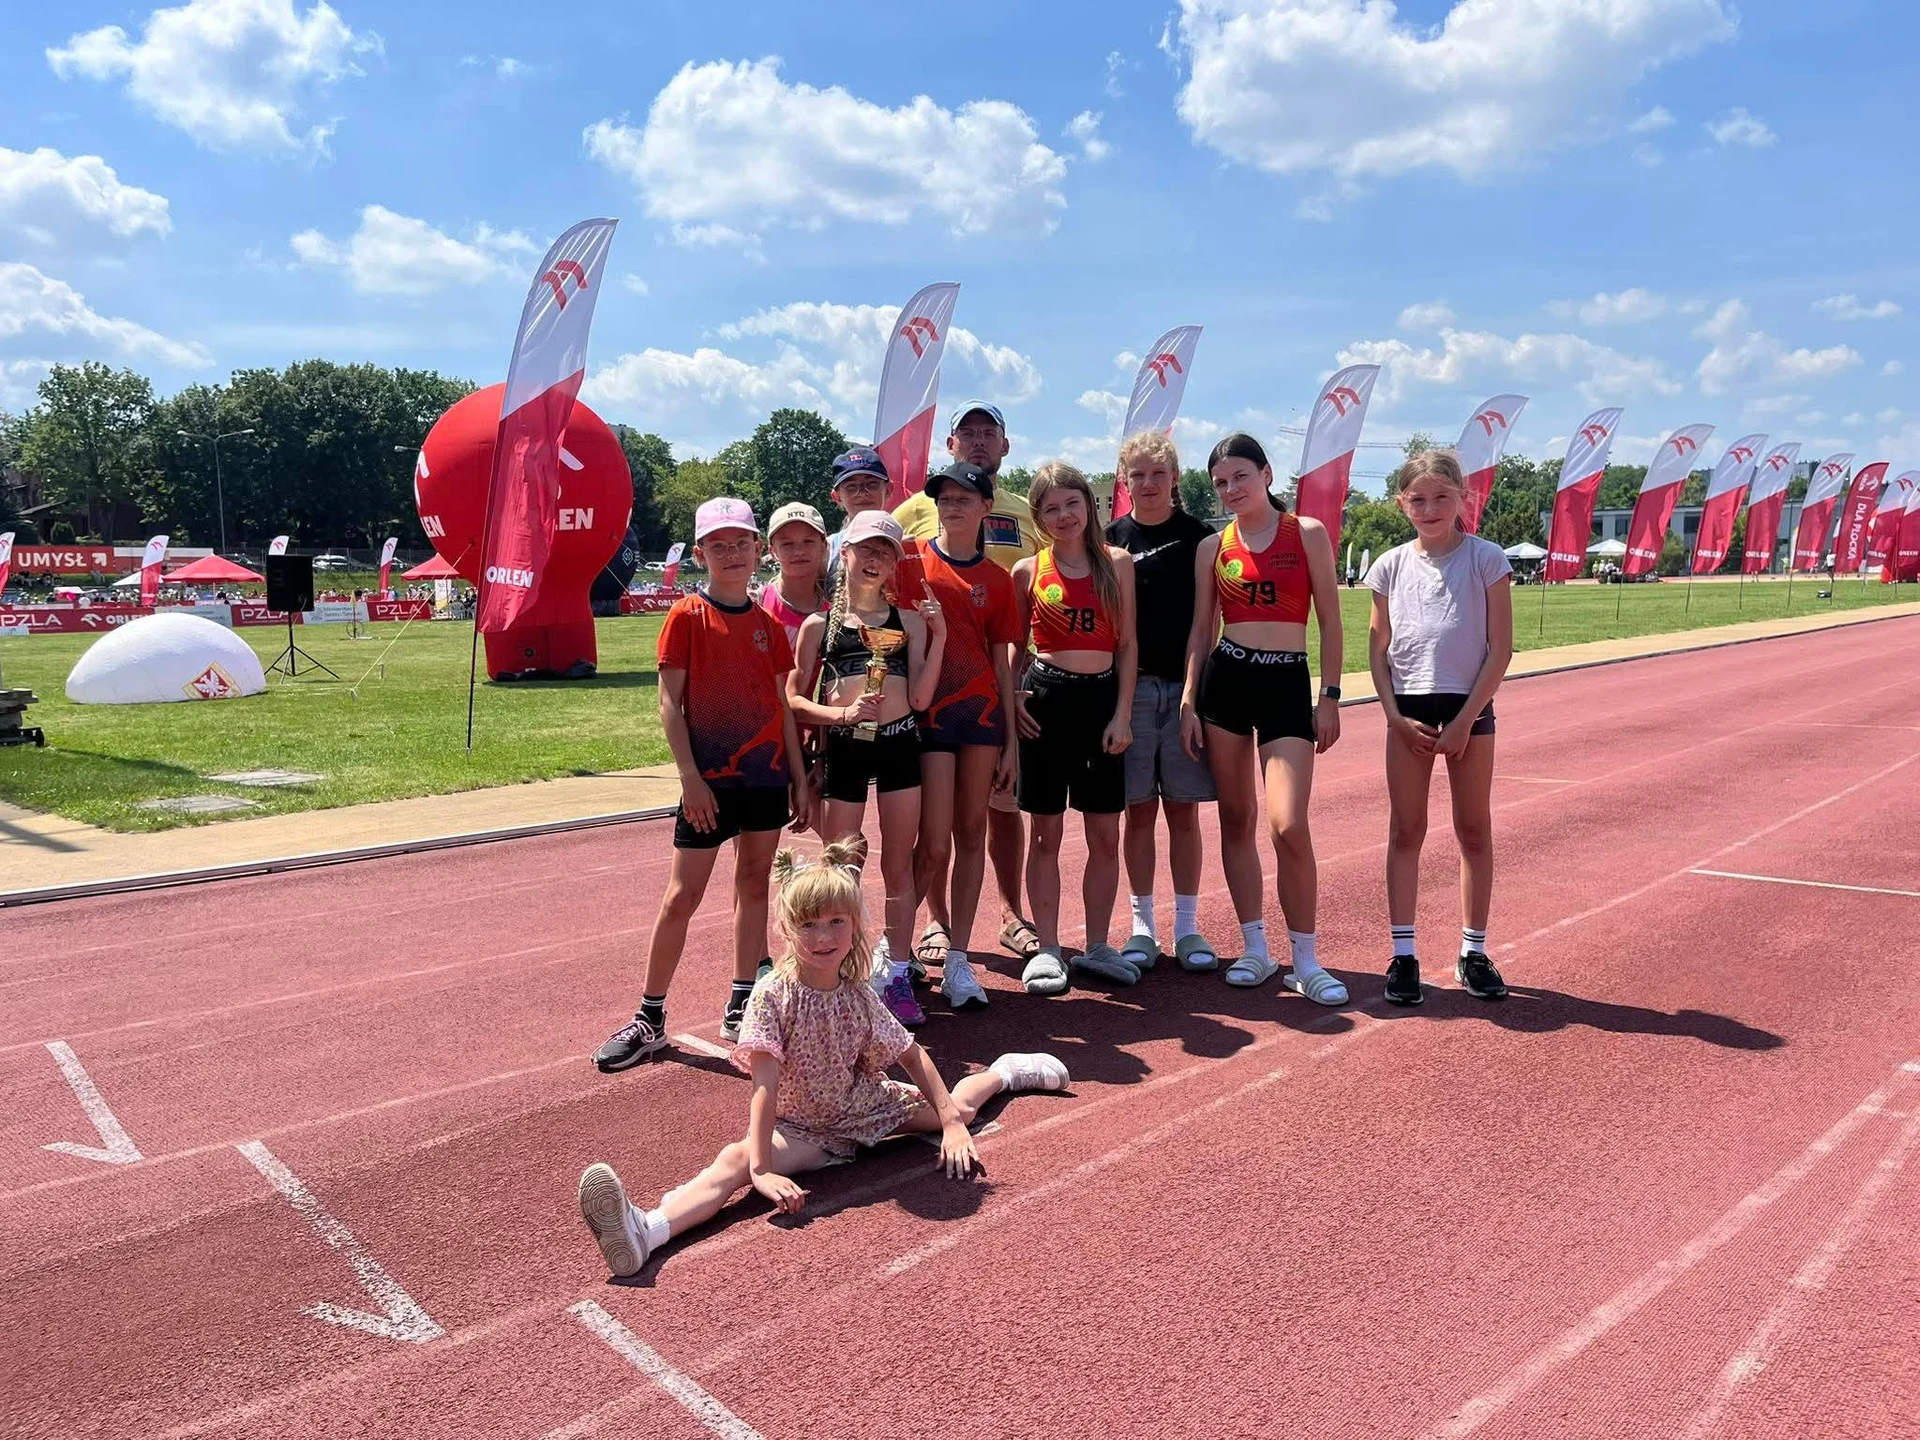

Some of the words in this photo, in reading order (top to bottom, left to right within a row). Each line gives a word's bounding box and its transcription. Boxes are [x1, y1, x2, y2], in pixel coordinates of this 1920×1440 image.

[555, 508, 594, 531] EN
[1854, 502, 1868, 521] DLA
[18, 552, 87, 567] UMYSŁ
[1550, 552, 1580, 563] ORLEN
[1629, 548, 1657, 560] ORLEN
[486, 566, 534, 588] ORLEN
[1241, 580, 1277, 606] 79
[376, 604, 422, 615] PZLA
[1, 613, 62, 627] PZLA
[1063, 607, 1097, 633] 78
[1220, 639, 1246, 659] PRO
[1250, 652, 1295, 664] NIKE
